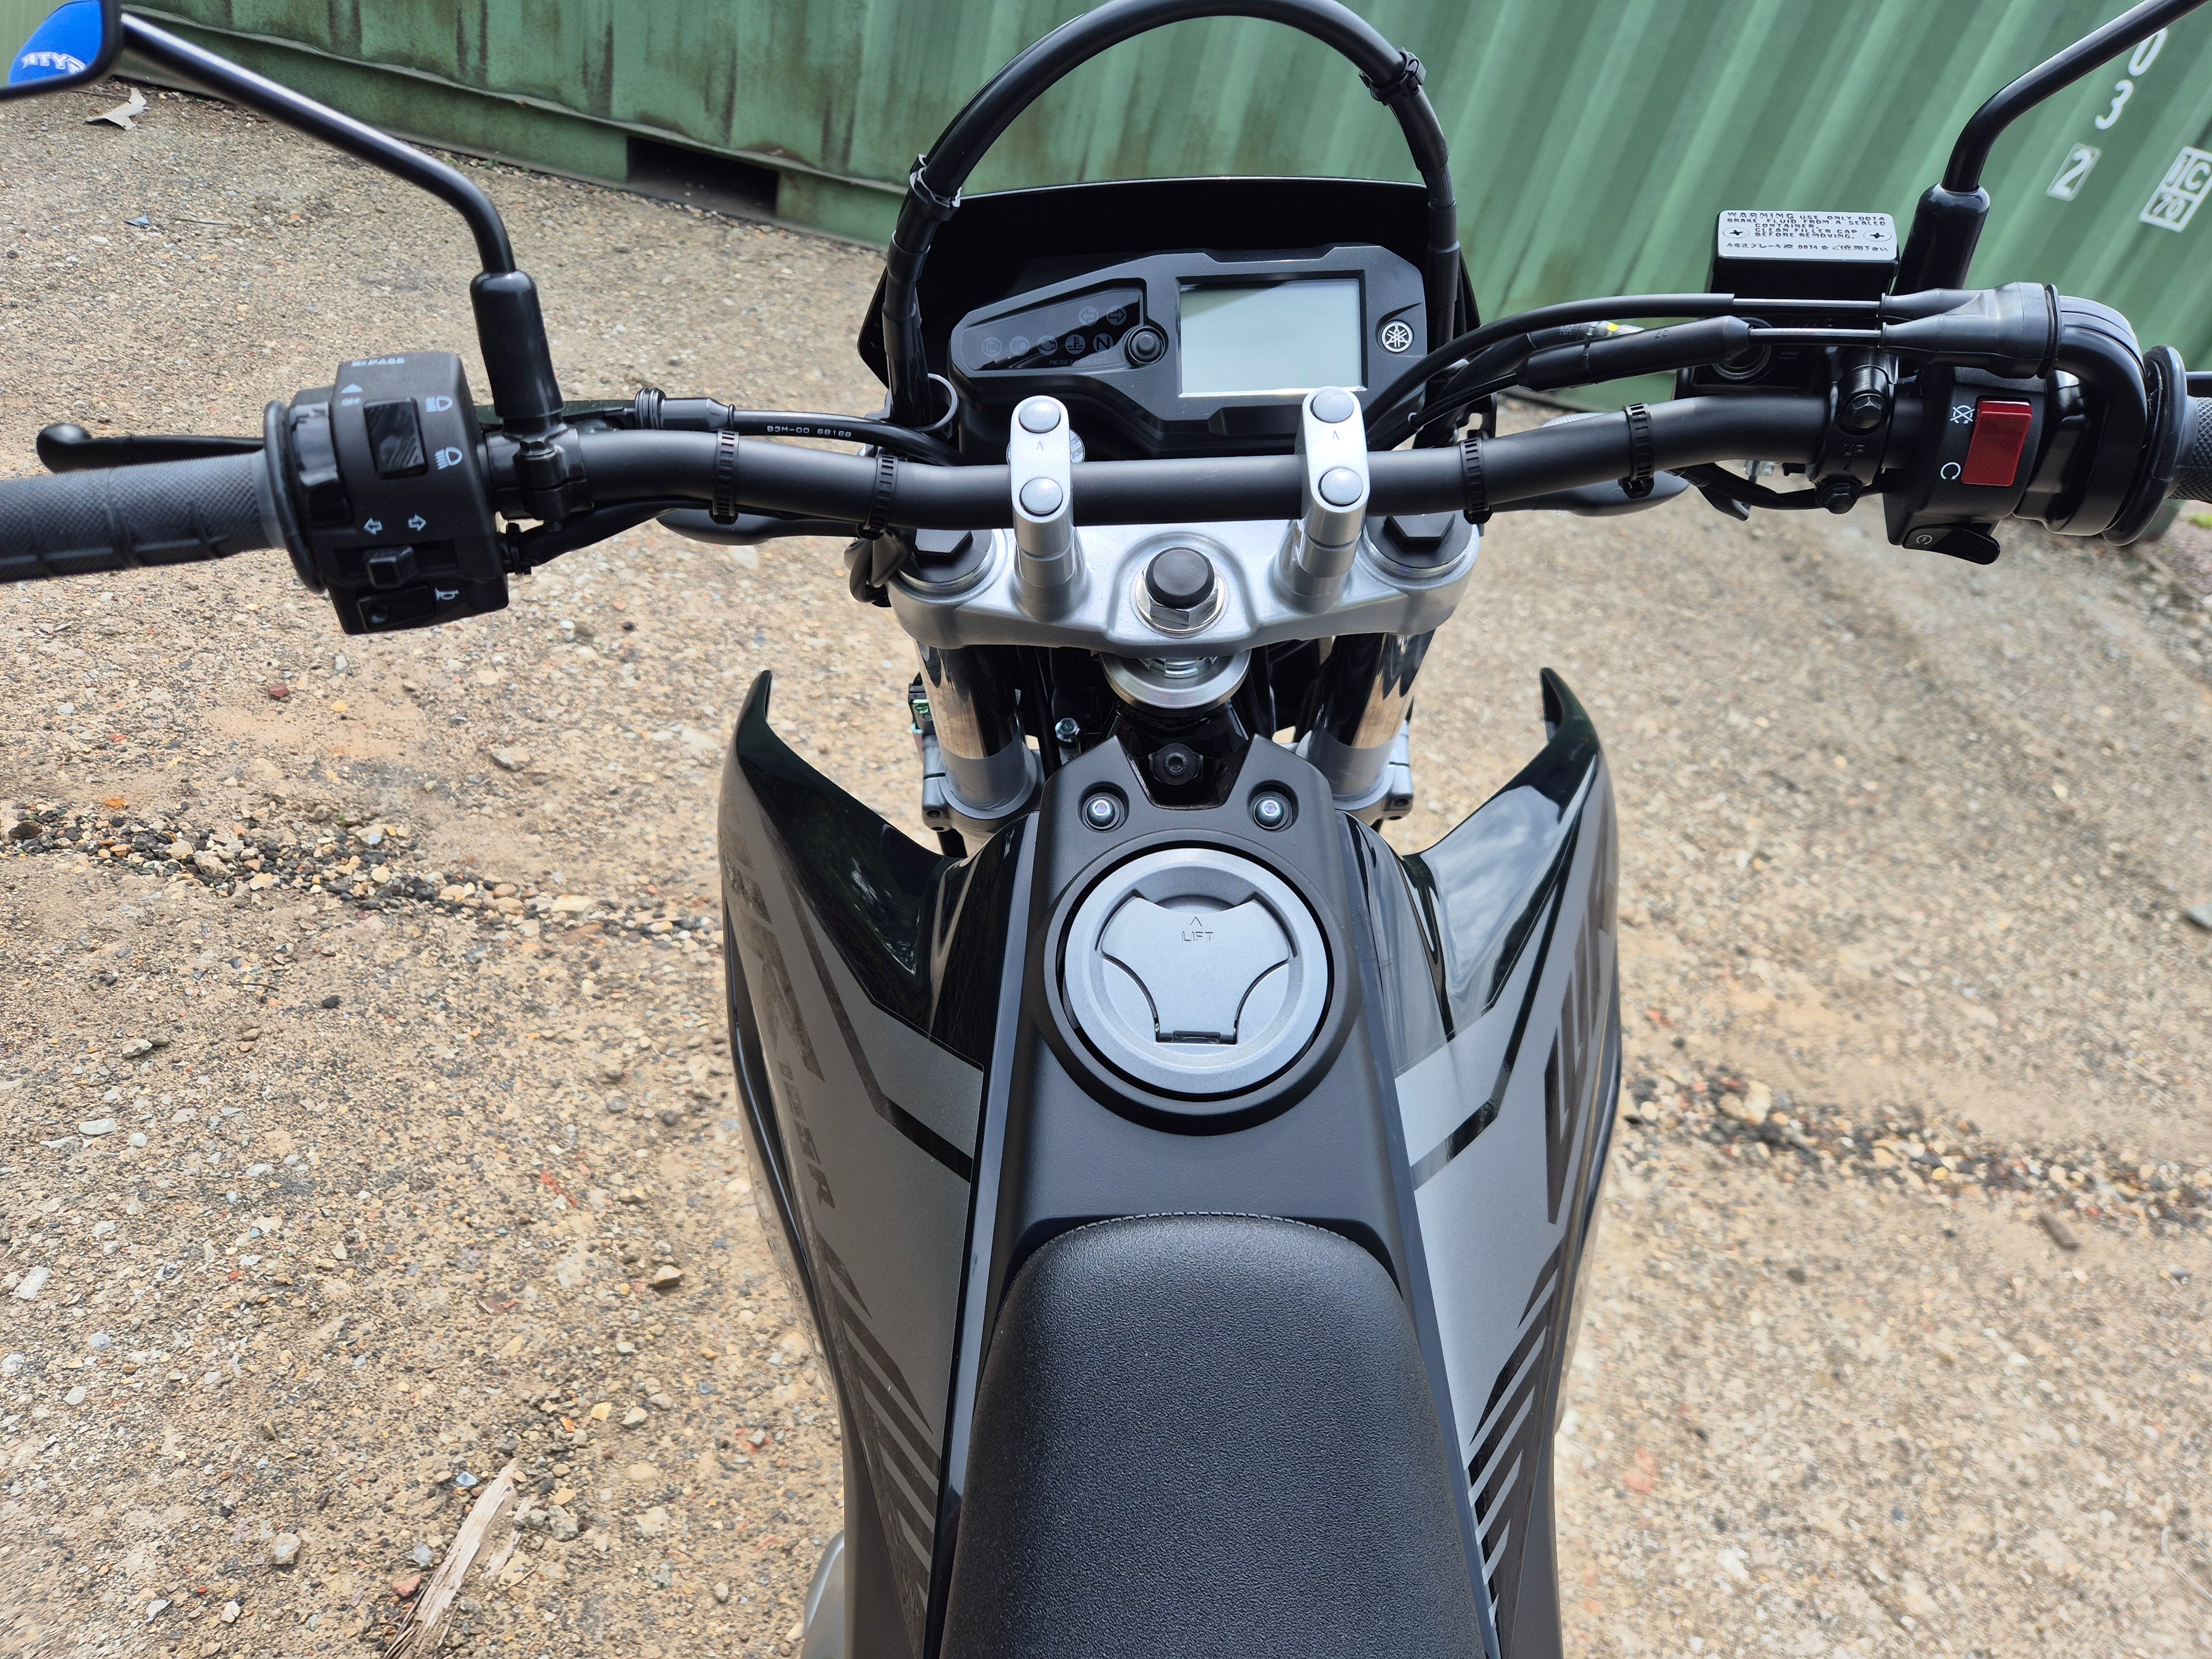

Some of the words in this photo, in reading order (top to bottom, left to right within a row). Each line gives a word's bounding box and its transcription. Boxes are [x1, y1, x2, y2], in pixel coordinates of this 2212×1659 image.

[2051, 149, 2092, 197] 2
[1096, 336, 1111, 350] N
[1842, 444, 1866, 457] UP
[1181, 930, 1214, 943] LIFT
